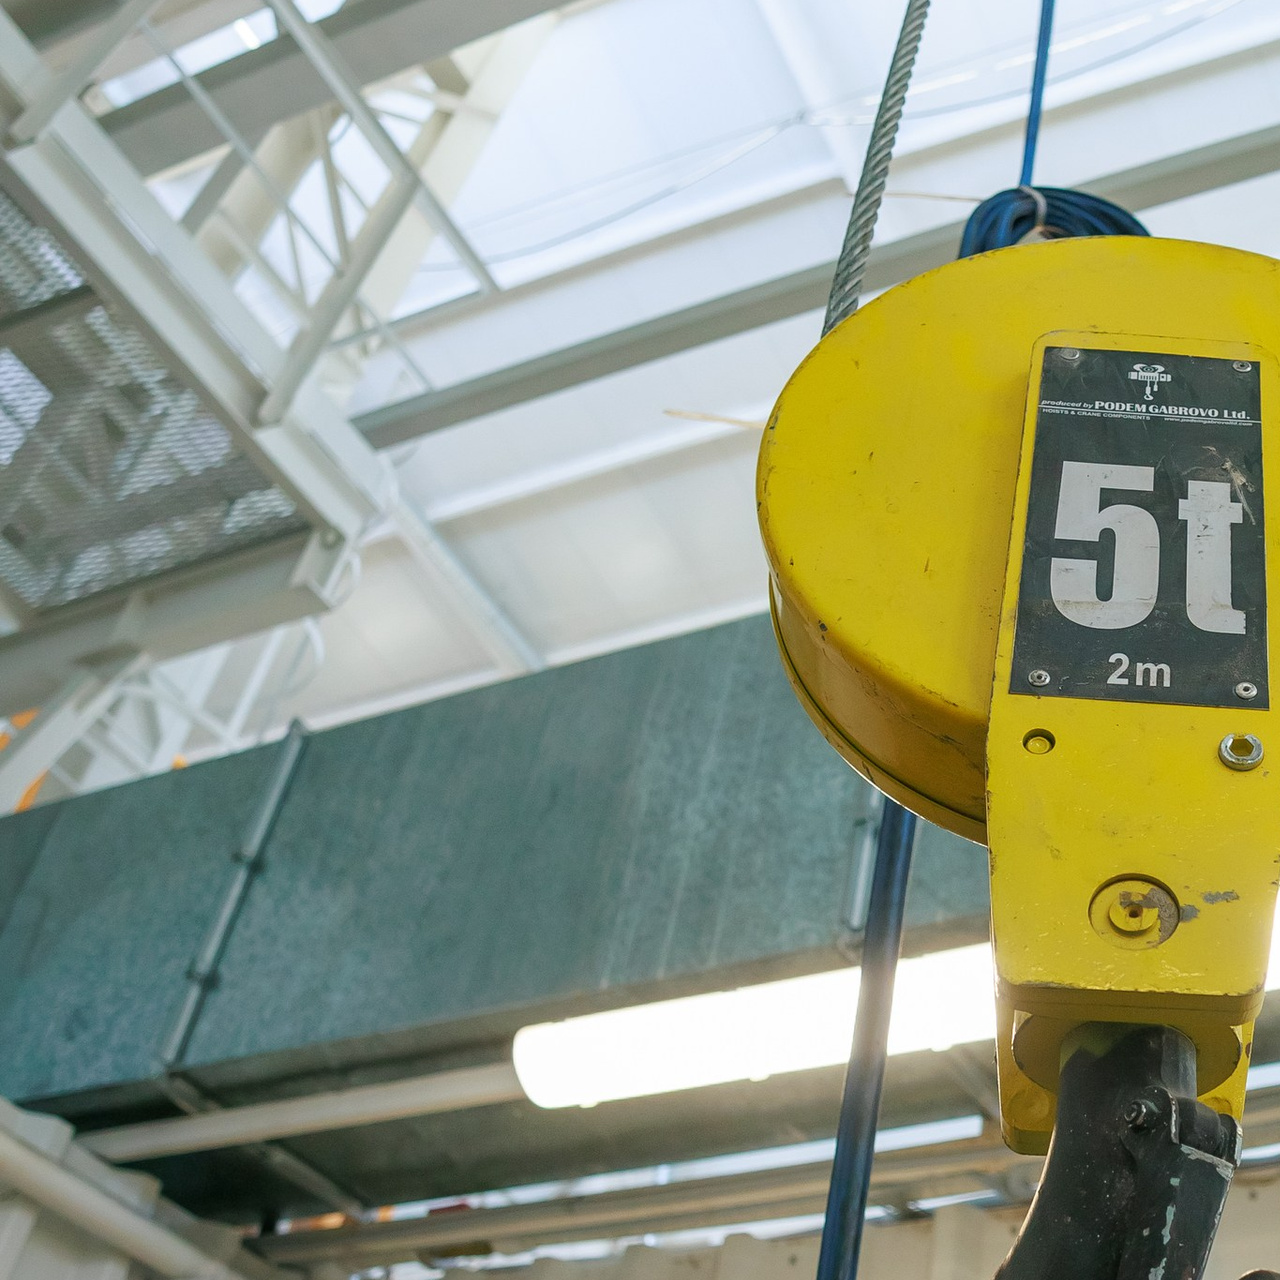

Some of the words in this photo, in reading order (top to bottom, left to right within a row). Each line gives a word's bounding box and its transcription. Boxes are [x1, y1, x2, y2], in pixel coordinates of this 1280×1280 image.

[1041, 399, 1081, 408] produced
[1094, 400, 1146, 413] PODEM
[1148, 404, 1219, 418] GABROVO
[1223, 409, 1250, 420] Ltd.
[1077, 410, 1102, 418] CRANE
[1103, 412, 1151, 421] COMPONENTS
